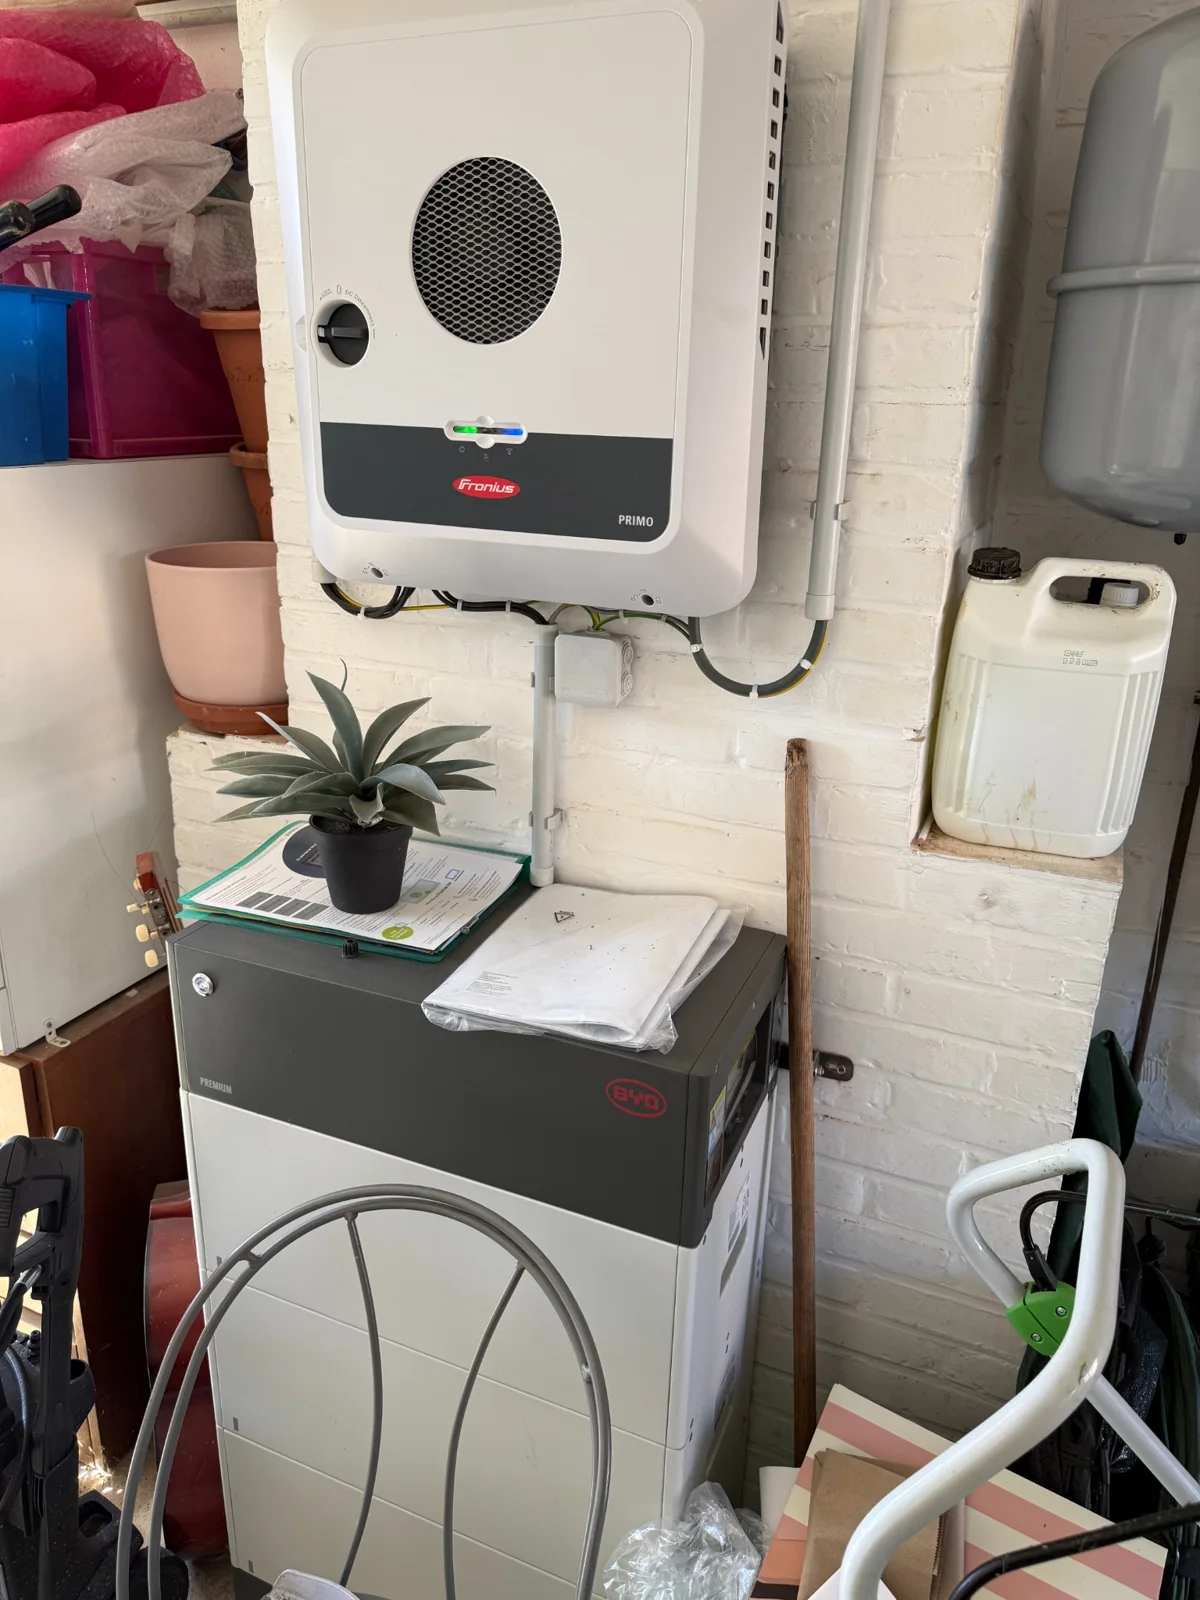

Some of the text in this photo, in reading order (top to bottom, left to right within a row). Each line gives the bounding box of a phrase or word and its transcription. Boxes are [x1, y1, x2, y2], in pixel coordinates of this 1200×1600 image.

[345, 289, 354, 297] DC
[458, 478, 516, 495] Fronius
[618, 514, 654, 527] PRIMO
[200, 1076, 233, 1095] PREMIUM
[613, 1084, 659, 1111] BYD
